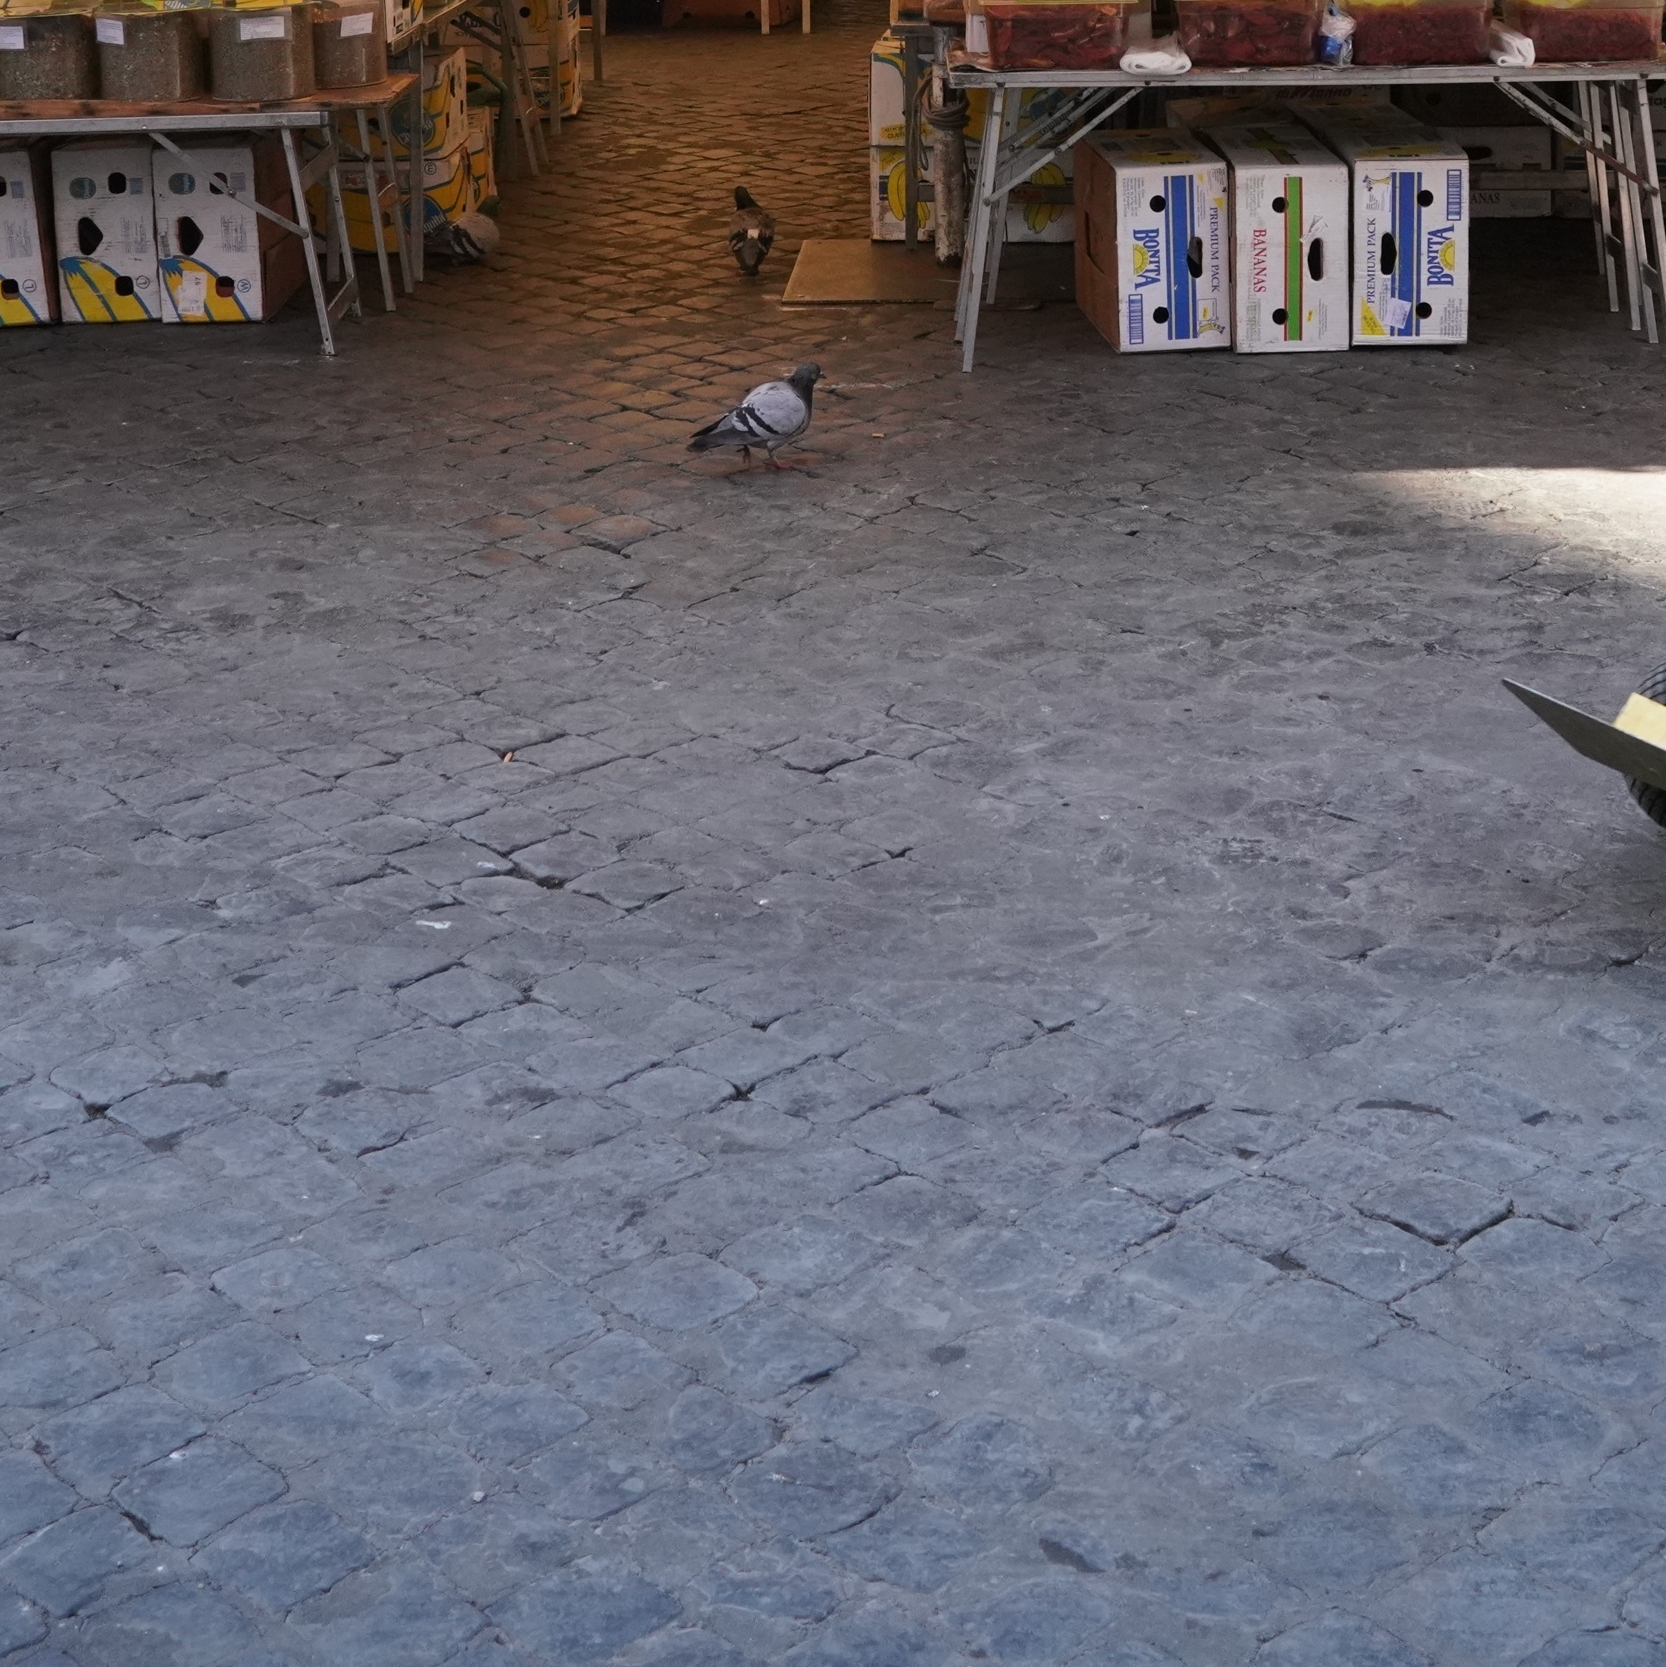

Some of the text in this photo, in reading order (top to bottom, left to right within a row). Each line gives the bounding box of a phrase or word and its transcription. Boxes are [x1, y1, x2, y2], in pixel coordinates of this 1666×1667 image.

[1133, 228, 1161, 291] BONITA
[1209, 206, 1221, 293] PREMIUM PACK
[1253, 229, 1267, 294] BANANAS
[1366, 218, 1376, 305] PREMIUM PACK
[1426, 224, 1455, 287] BONITA
